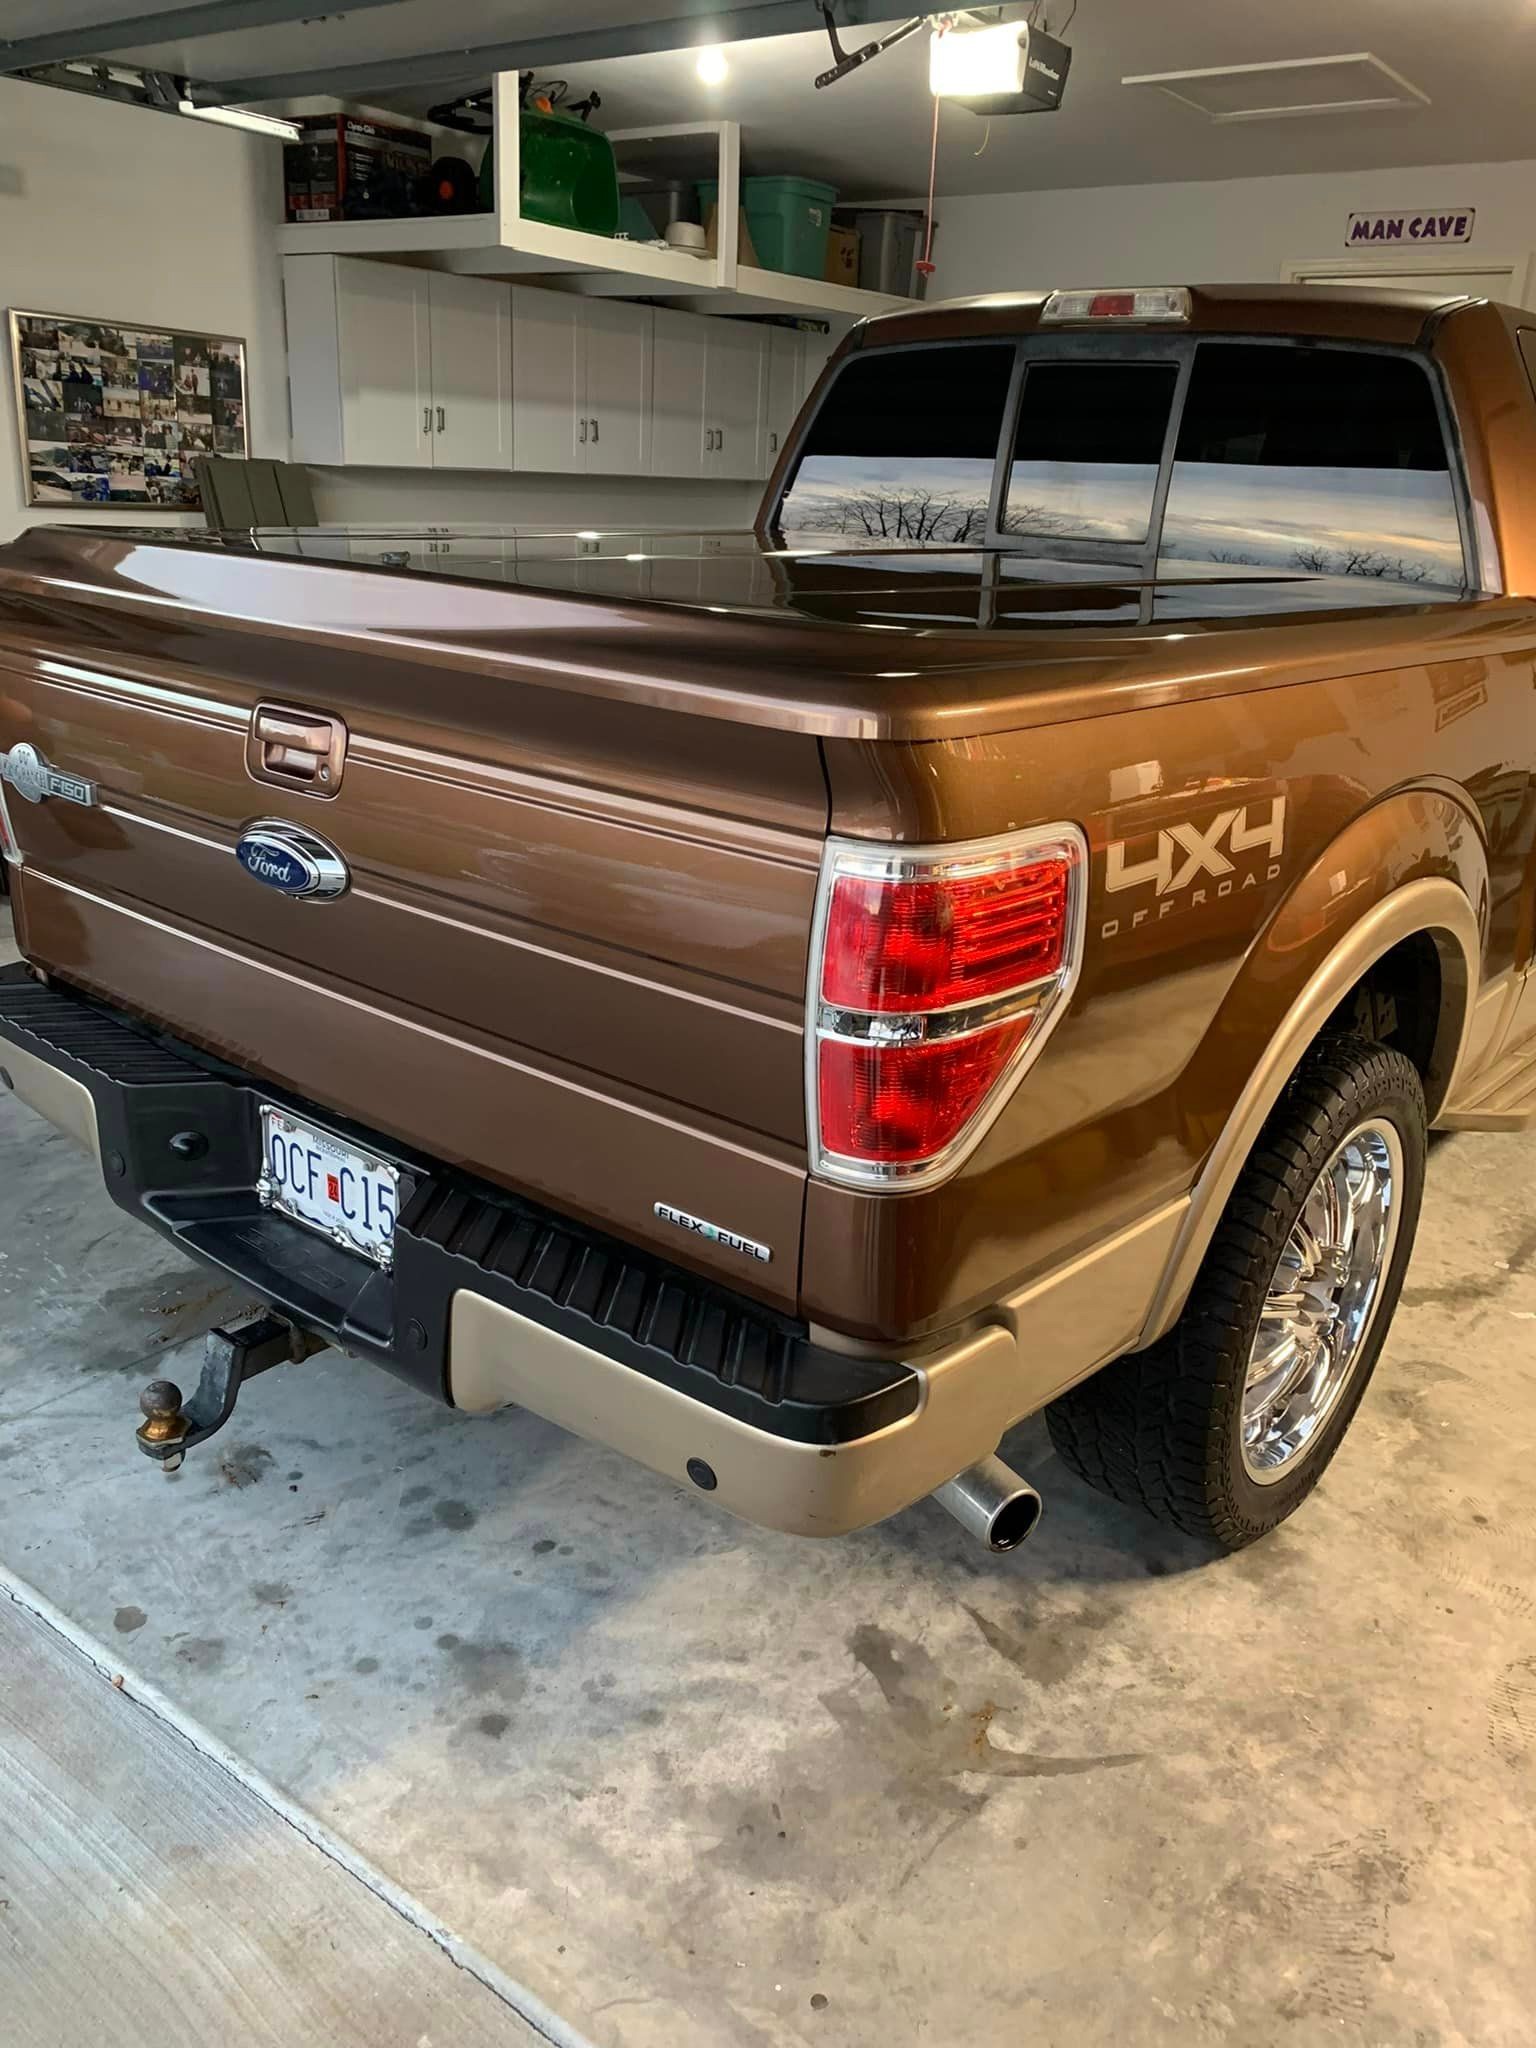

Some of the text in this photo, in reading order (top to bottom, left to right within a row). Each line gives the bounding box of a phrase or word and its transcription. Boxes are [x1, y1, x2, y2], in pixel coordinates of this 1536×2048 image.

[1350, 216, 1467, 240] MAN CAVE
[50, 777, 85, 800] F-150
[247, 842, 291, 882] Ford
[1105, 795, 1286, 896] 4X4
[1101, 864, 1281, 939] OFF ROAD
[340, 1167, 396, 1239] C15
[659, 1206, 765, 1261] FLEX FUEL
